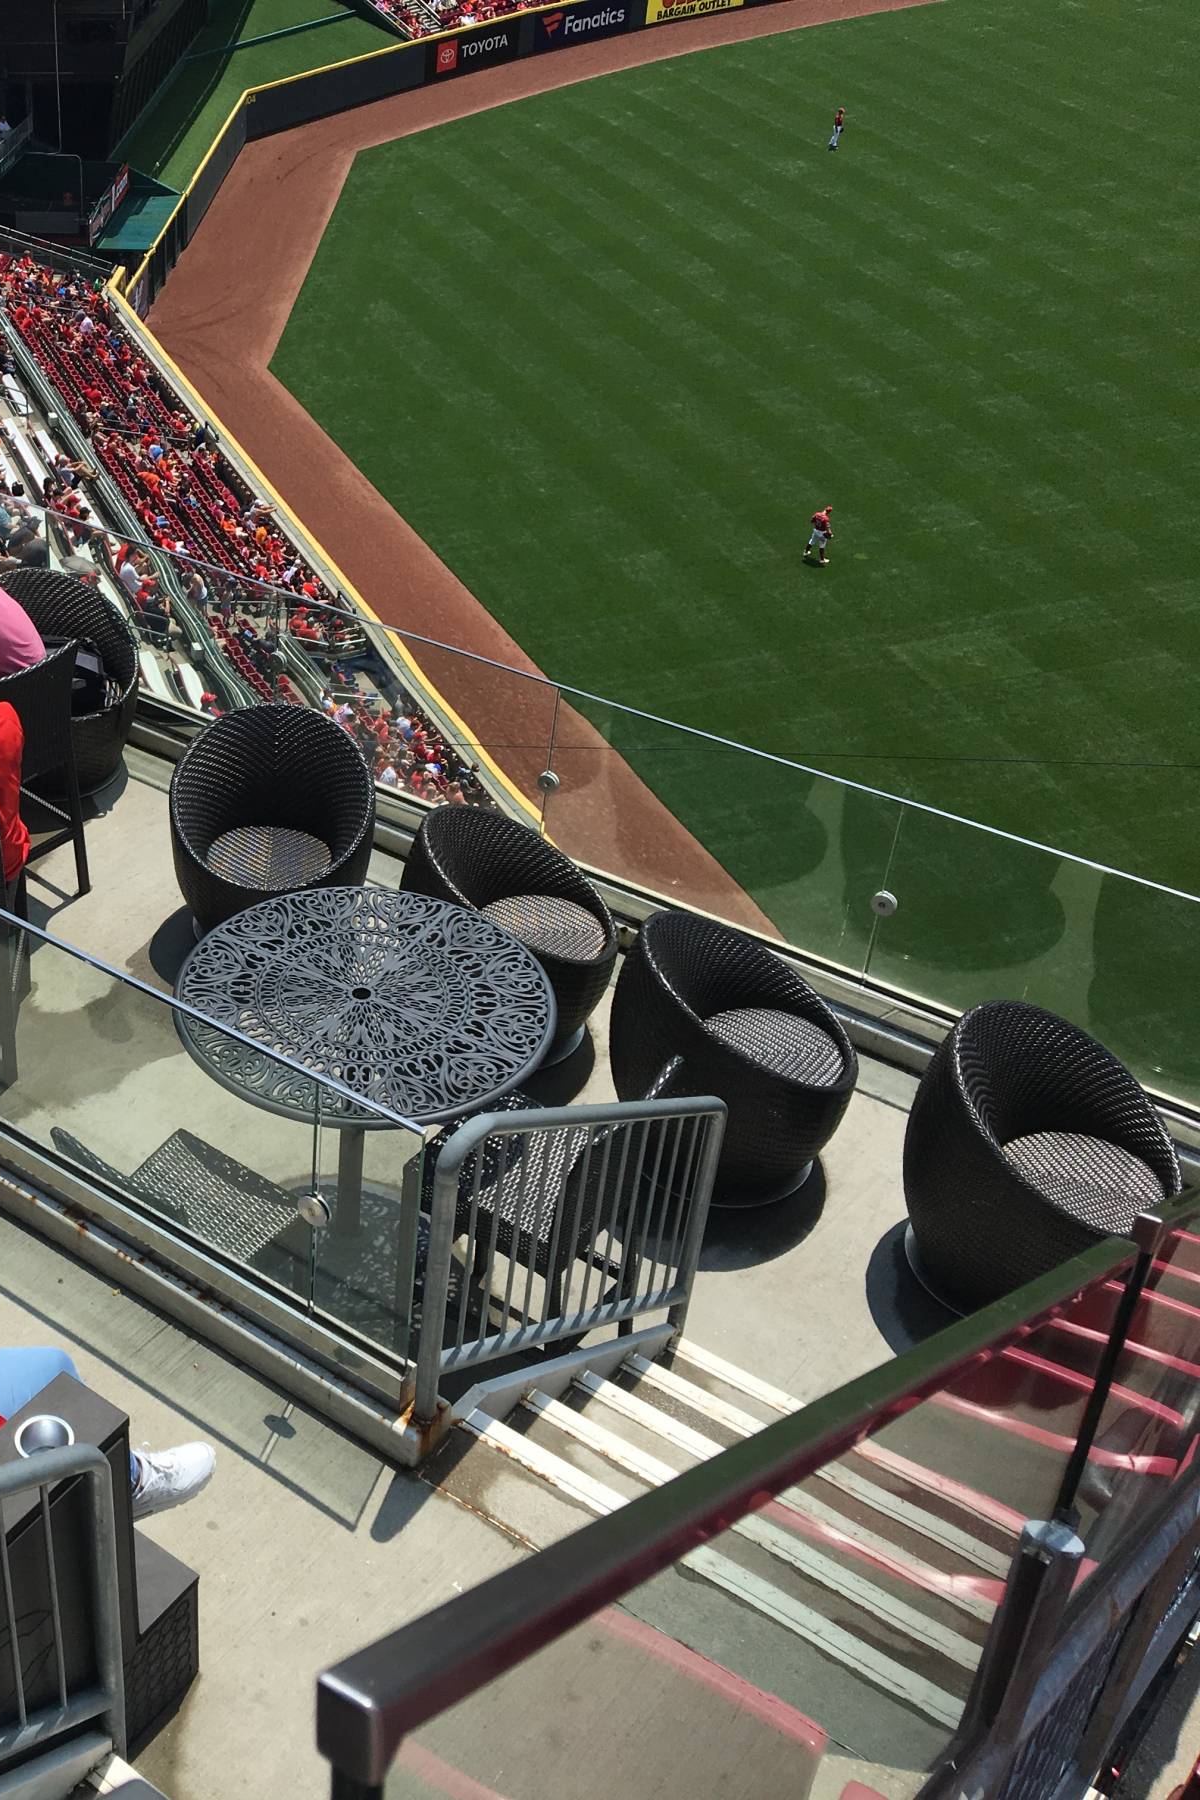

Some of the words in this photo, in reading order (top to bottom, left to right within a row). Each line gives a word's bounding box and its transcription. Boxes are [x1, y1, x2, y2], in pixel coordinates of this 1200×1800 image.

[565, 8, 625, 35] Fanatics
[657, 4, 695, 20] BARGAIN
[699, 0, 731, 11] OUTLET
[461, 34, 509, 58] TOYOTA
